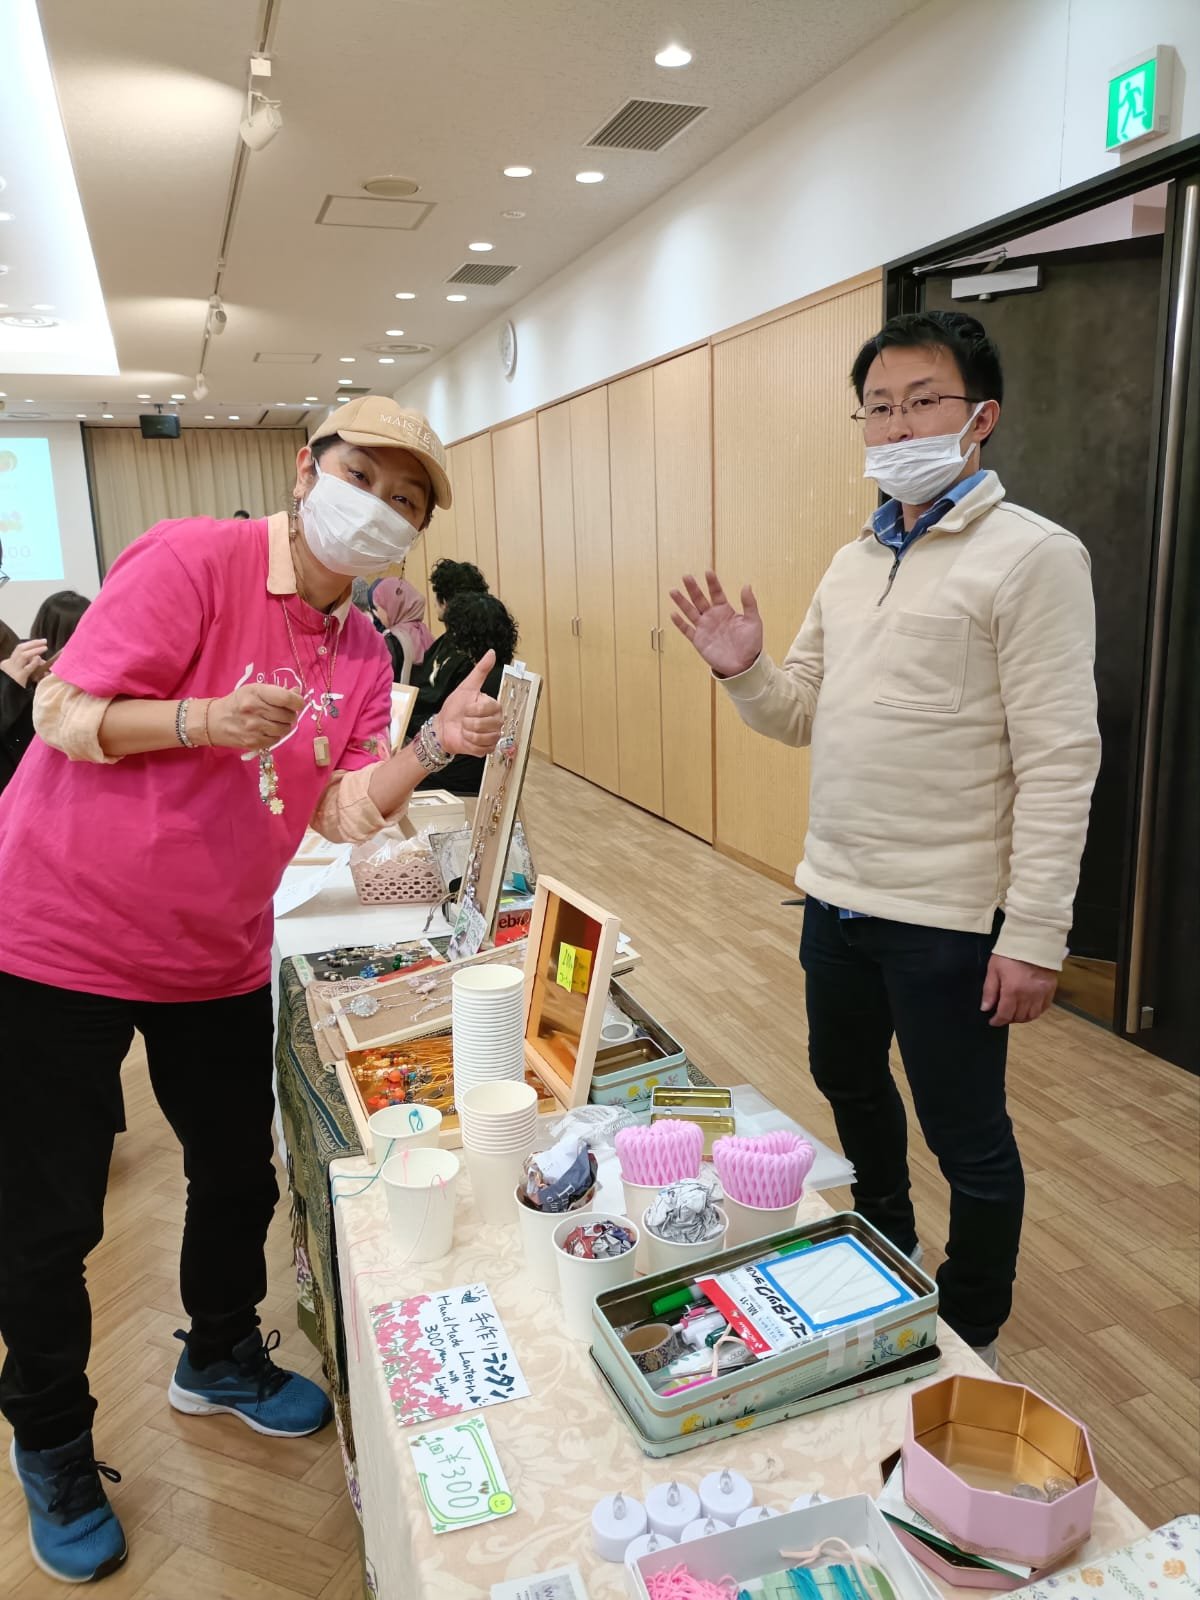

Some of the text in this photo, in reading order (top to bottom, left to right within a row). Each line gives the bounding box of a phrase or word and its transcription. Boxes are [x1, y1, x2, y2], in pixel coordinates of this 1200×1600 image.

[740, 1296, 759, 1316] ML-11
[425, 1324, 445, 1347] 300
[469, 1312, 515, 1399] 手作りランタン
[458, 1351, 477, 1395] Lantern
[434, 1376, 450, 1400] Light
